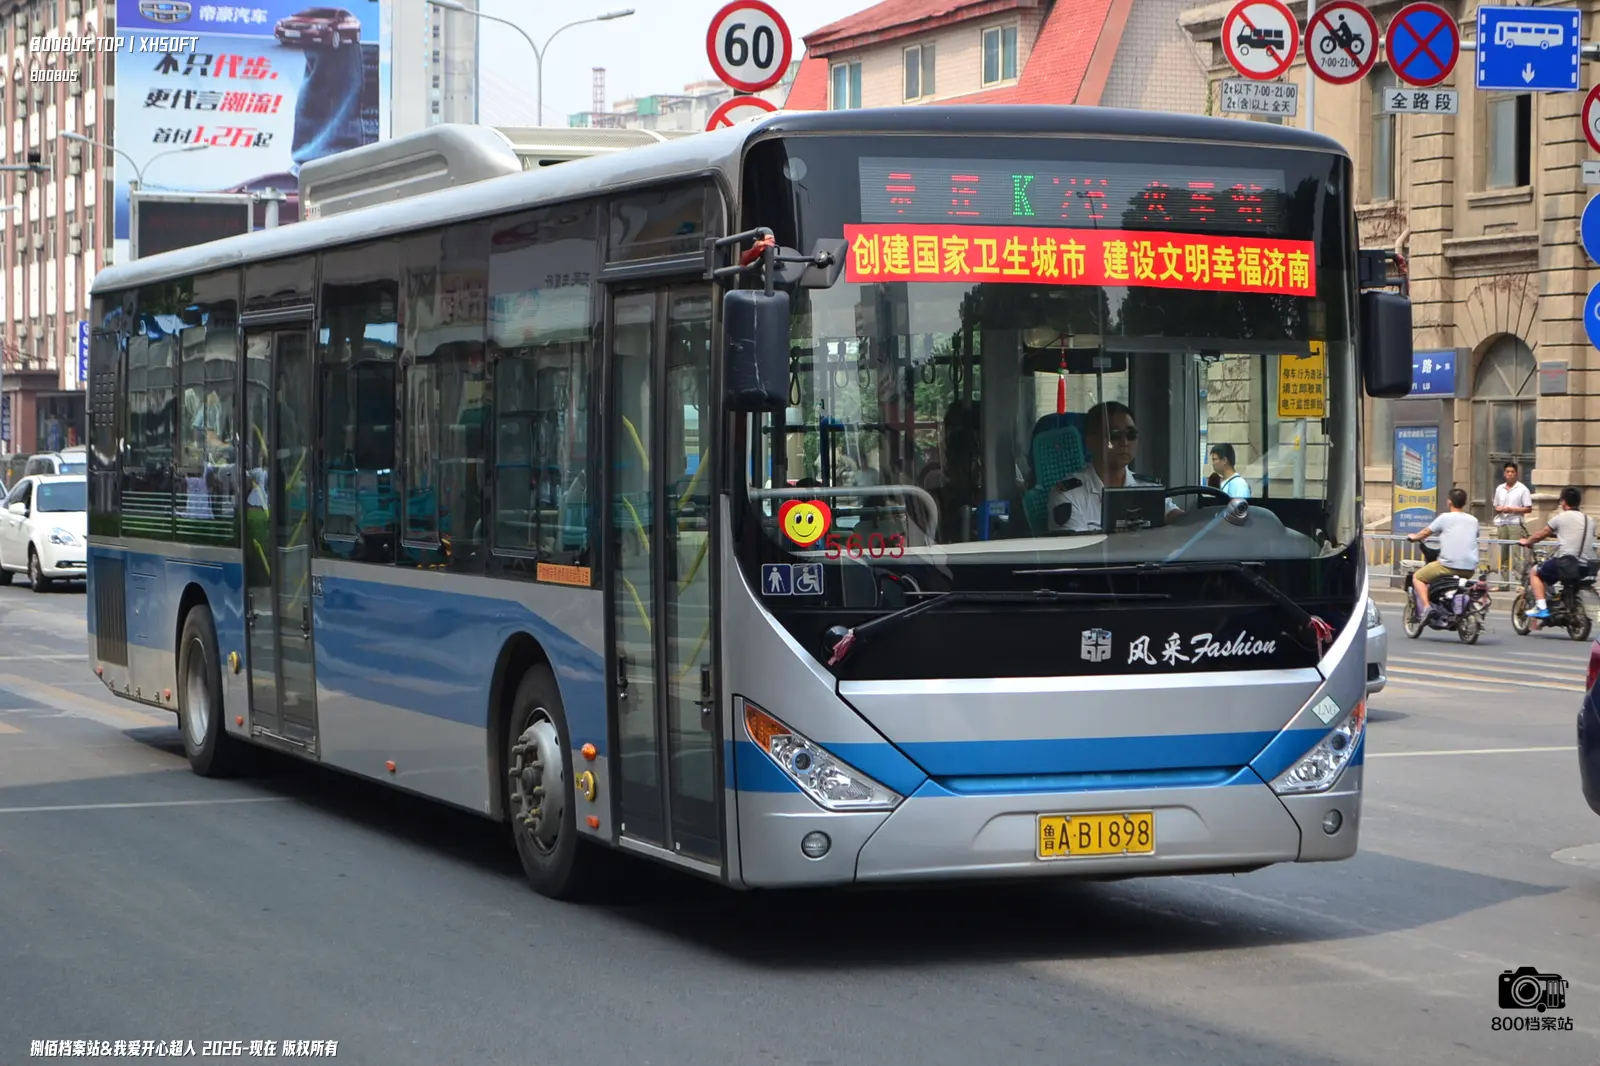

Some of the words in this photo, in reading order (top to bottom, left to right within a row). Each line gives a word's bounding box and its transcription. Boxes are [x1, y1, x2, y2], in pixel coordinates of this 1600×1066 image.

[199, 5, 269, 25] 帝豪汽车
[724, 22, 775, 70] 60
[1272, 100, 1291, 112] 全天
[1391, 92, 1452, 111] 全路段
[152, 125, 274, 148] 首付1.2万起
[852, 232, 1086, 280] 创建国家卫生城市
[1103, 239, 1310, 290] 建设文明幸福济南
[824, 533, 906, 560] 5603
[1127, 632, 1190, 667] 风采
[1190, 630, 1277, 664] Fashion
